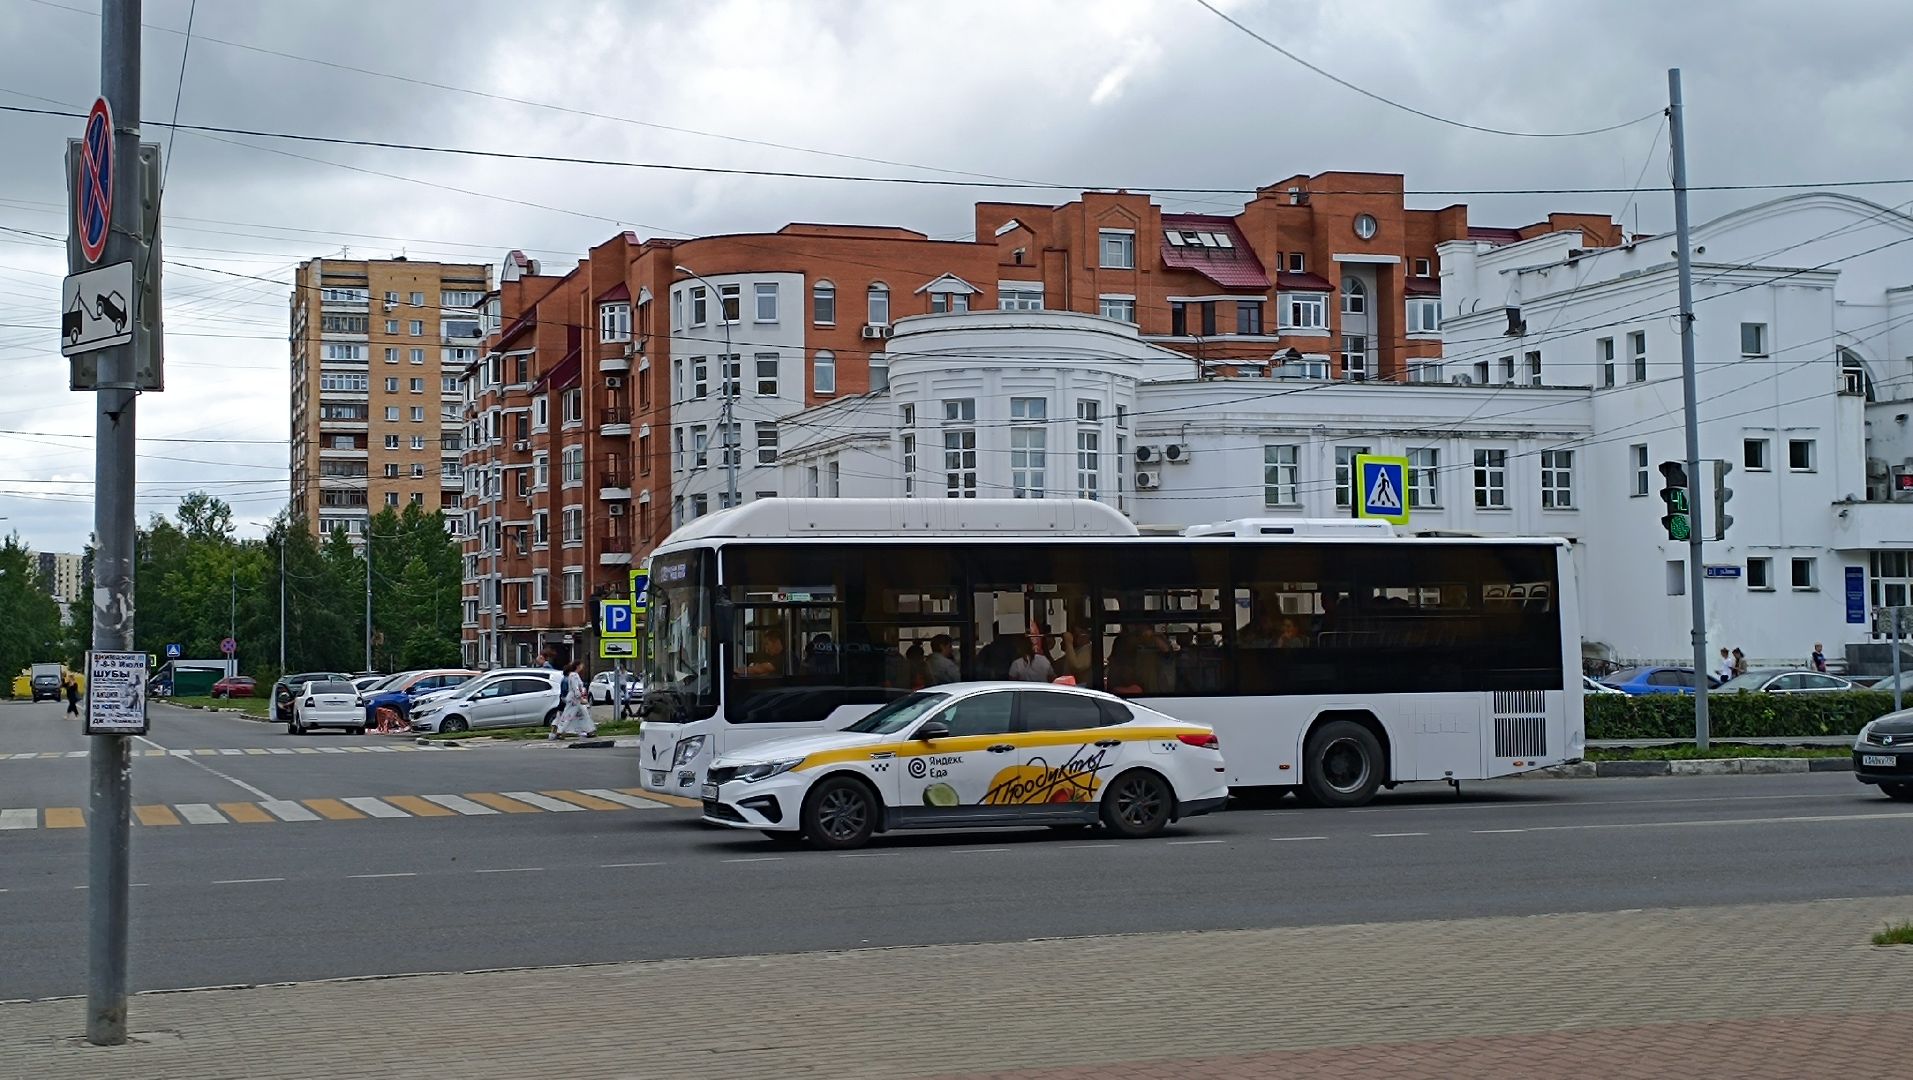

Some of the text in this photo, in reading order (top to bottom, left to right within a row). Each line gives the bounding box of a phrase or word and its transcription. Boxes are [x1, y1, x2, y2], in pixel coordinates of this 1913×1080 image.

[612, 607, 627, 630] P
[94, 670, 130, 678] ШУБЫ
[929, 756, 964, 766] Яндекс
[929, 768, 948, 778] Еда
[976, 743, 1114, 805] Продукты
